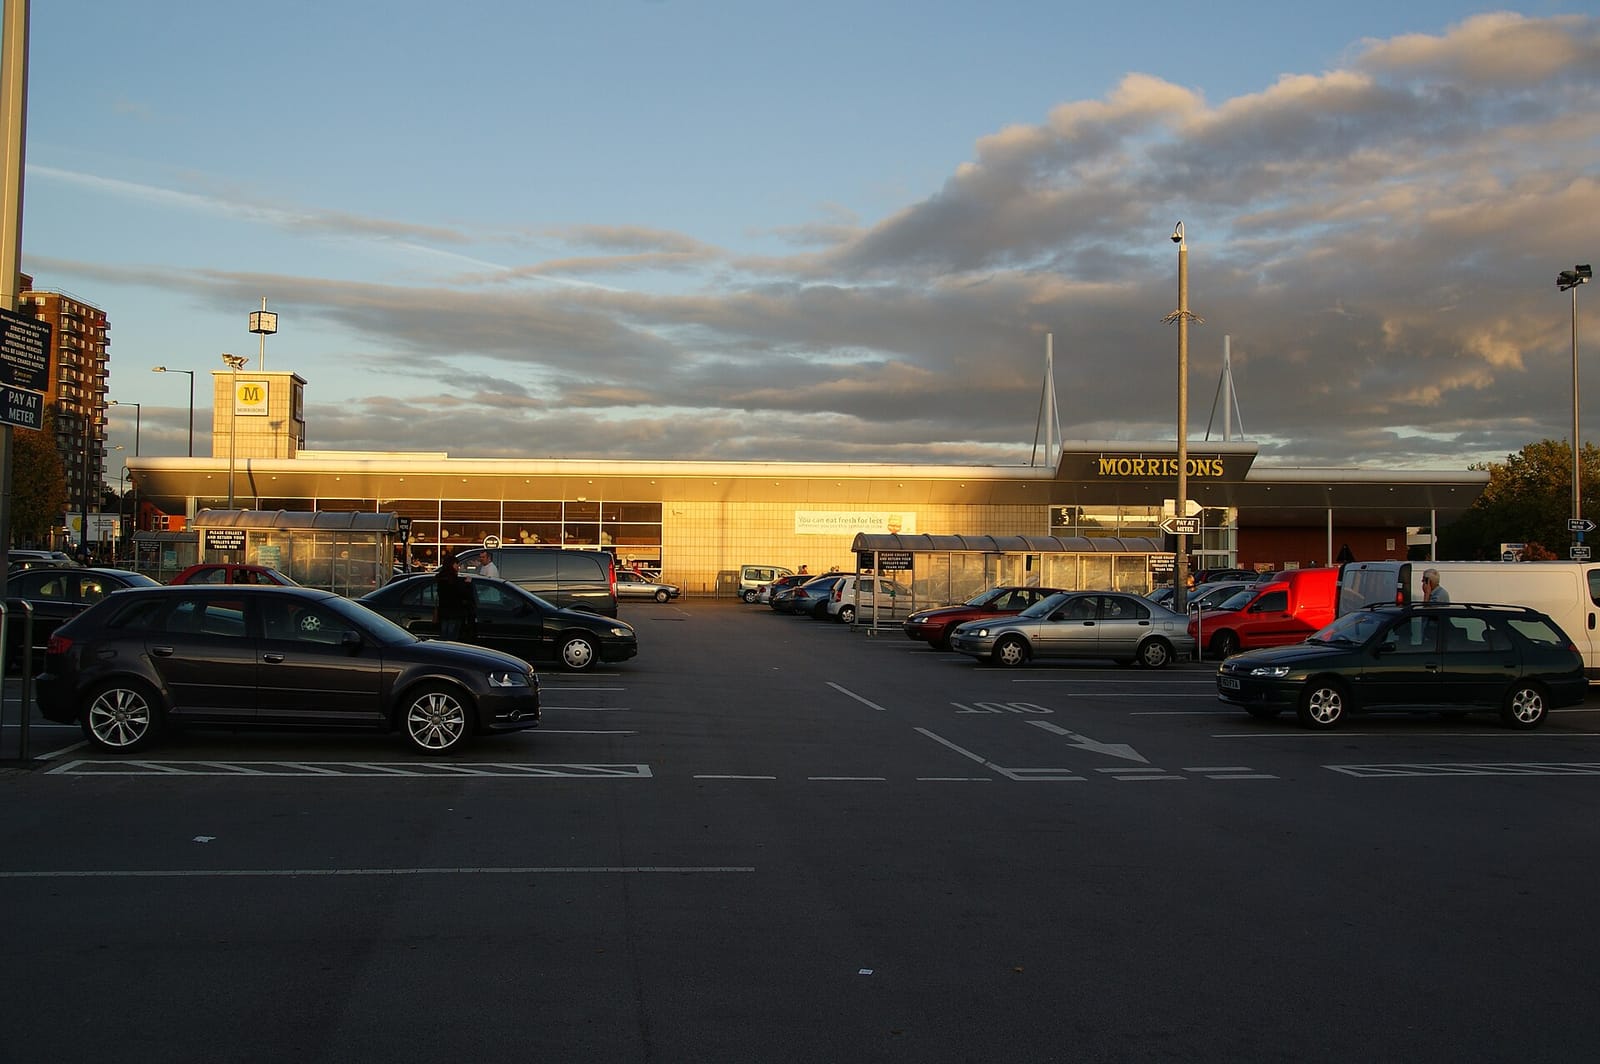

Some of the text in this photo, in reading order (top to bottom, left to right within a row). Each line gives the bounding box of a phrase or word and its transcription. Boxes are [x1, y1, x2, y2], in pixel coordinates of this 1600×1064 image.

[8, 391, 37, 409] PAY AT
[243, 387, 260, 401] M
[8, 407, 34, 424] METER
[1098, 458, 1224, 476] MORRISONS
